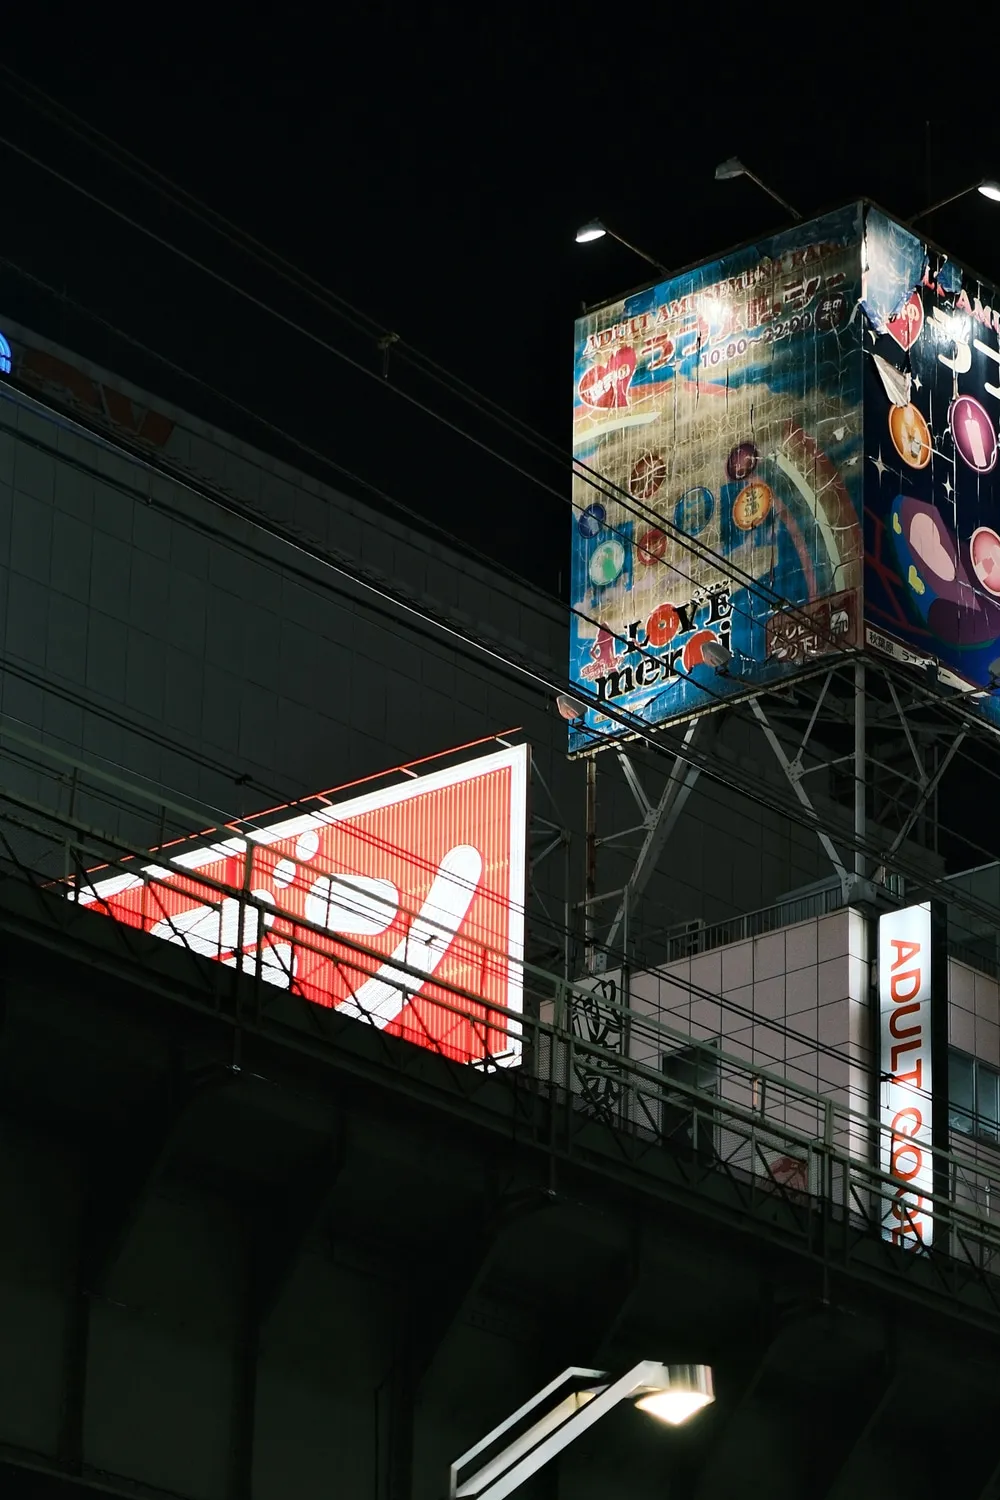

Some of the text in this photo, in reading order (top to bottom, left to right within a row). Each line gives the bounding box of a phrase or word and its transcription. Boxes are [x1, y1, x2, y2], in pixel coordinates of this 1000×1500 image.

[582, 316, 648, 356] ADULT
[624, 589, 734, 654] LOVE
[869, 630, 895, 655] 秋葉原
[889, 939, 923, 1090] ADULT
